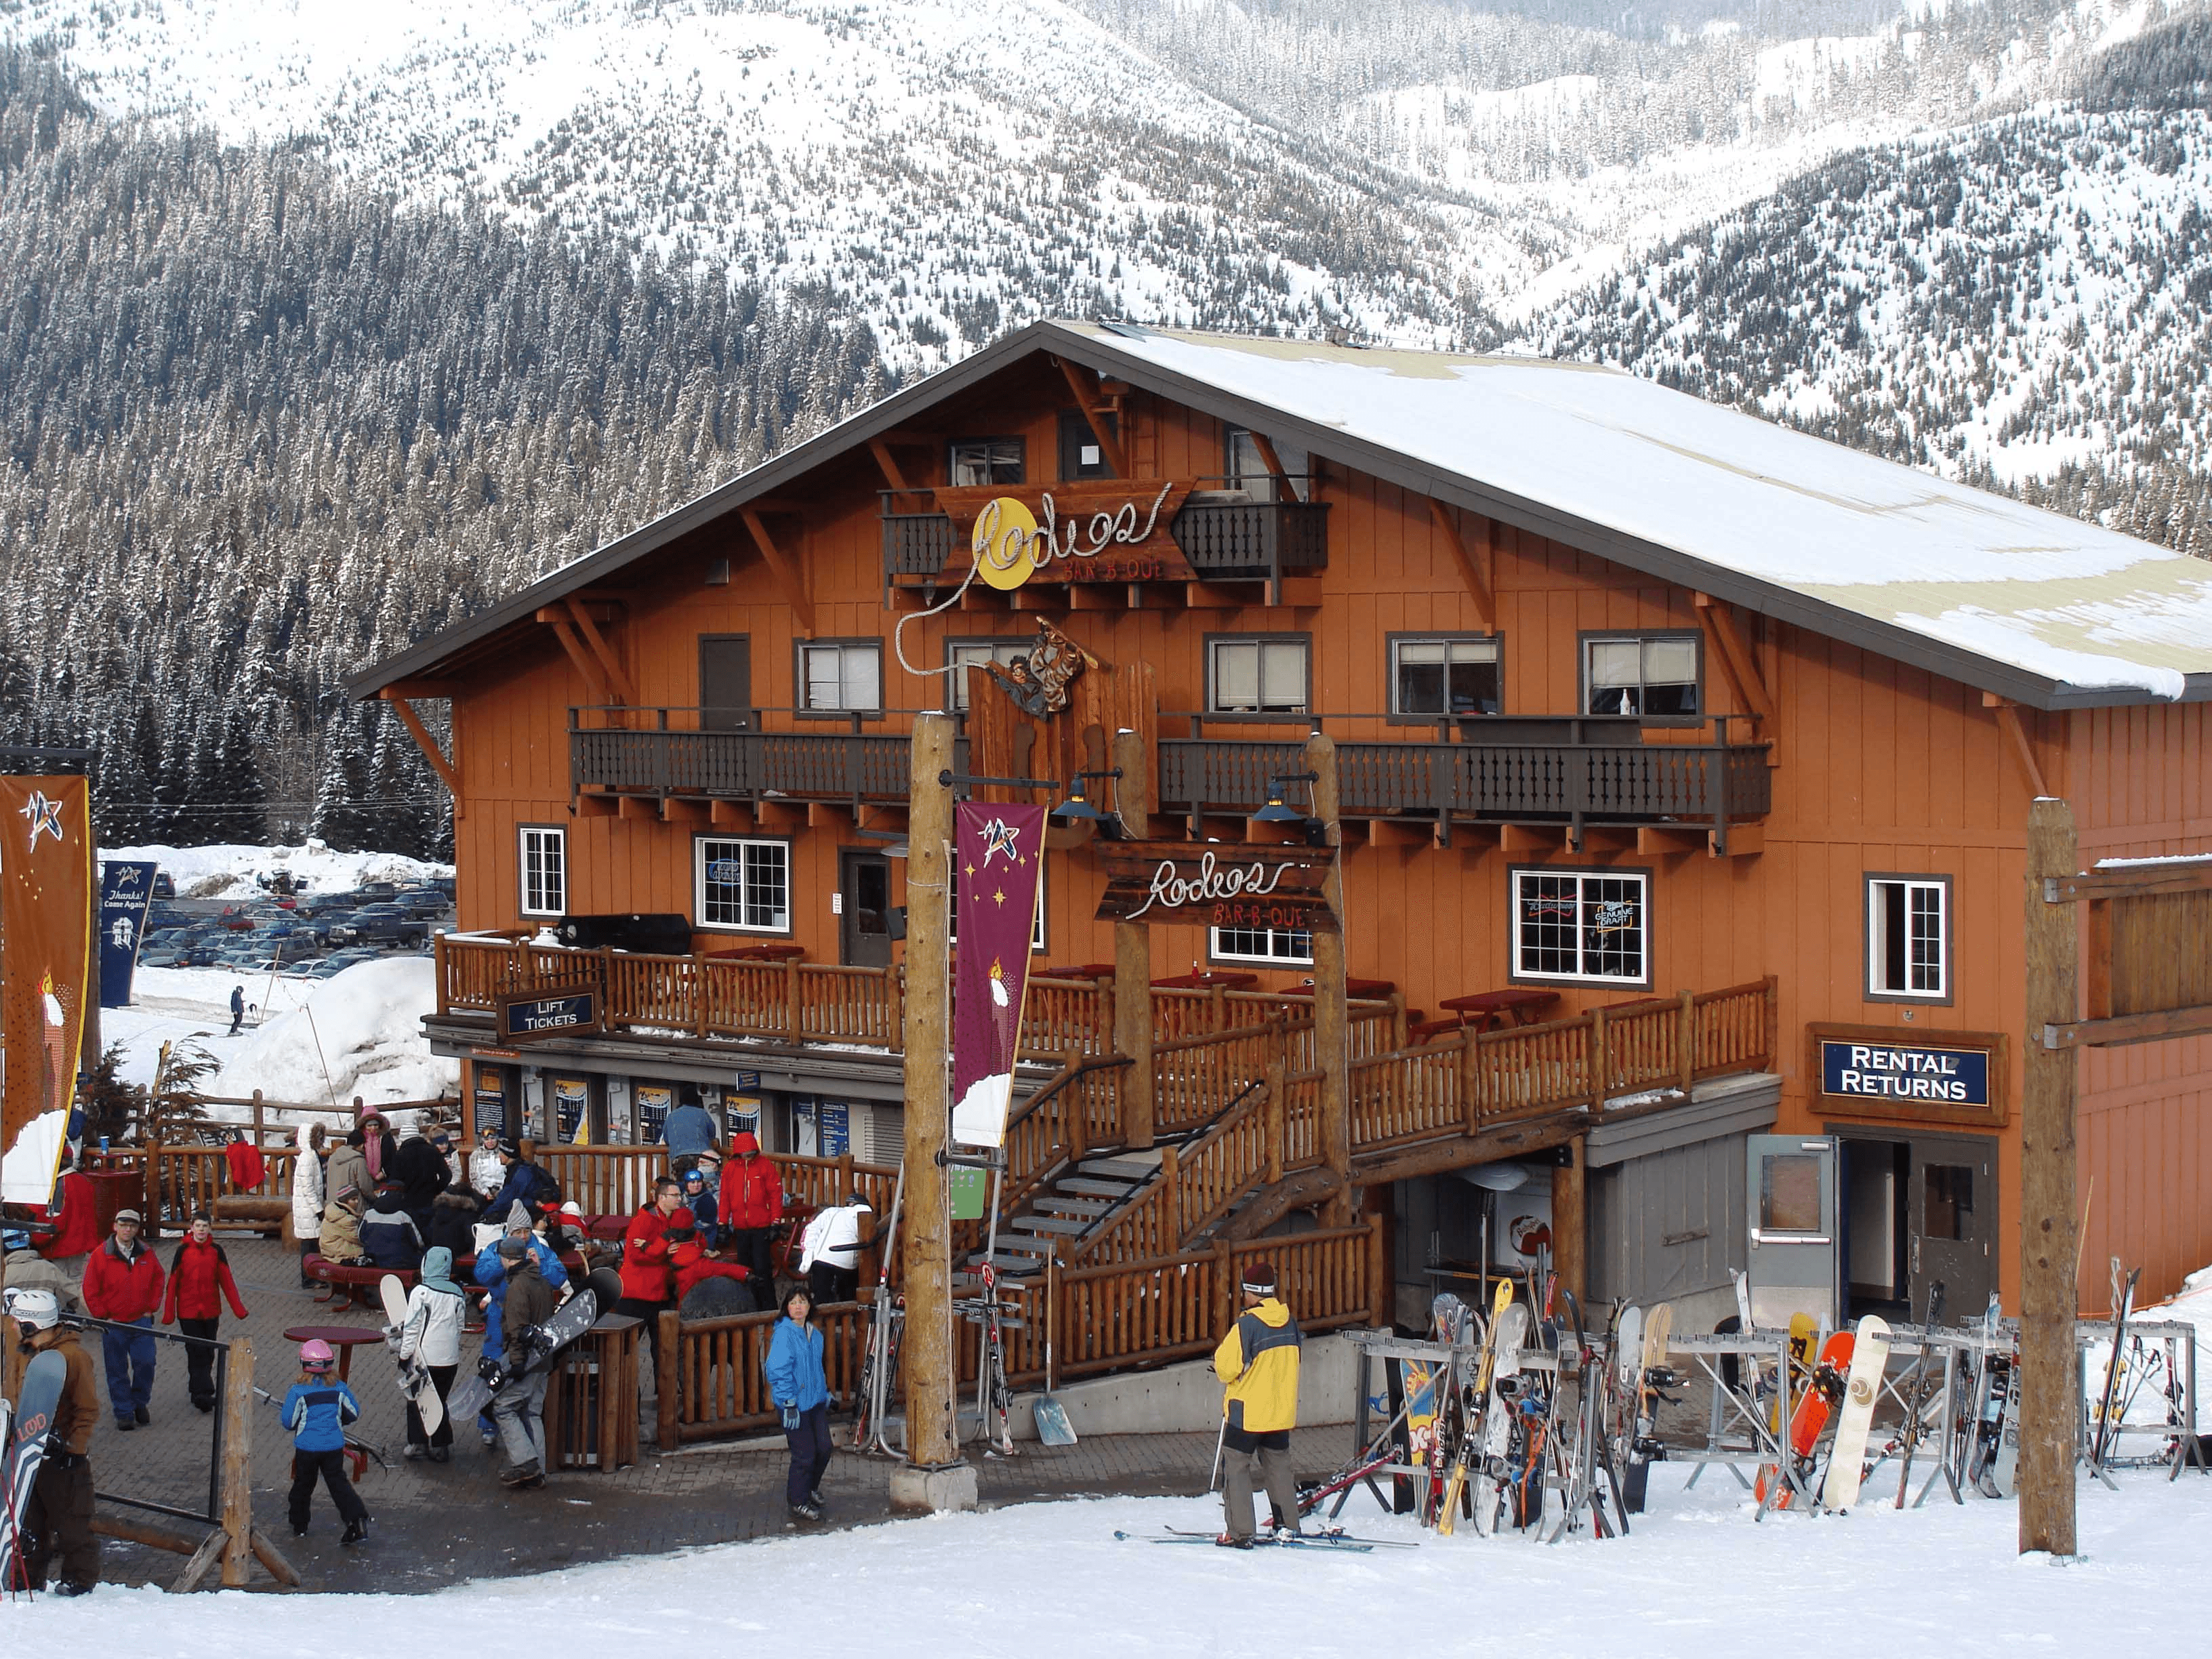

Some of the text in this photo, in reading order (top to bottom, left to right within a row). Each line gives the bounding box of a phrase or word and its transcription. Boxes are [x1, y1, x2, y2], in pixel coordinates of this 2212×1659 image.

[972, 481, 1172, 569] Rodeos
[1126, 851, 1295, 920] Rodeos
[108, 890, 144, 900] Thanks!
[104, 900, 146, 910] Come Again
[1595, 907, 1634, 921] GENUINE
[1600, 915, 1629, 926] DRAFT
[537, 1000, 565, 1015] LIFT
[525, 1014, 577, 1029] TICKETS
[1851, 1046, 1957, 1076] RENTAL
[1841, 1069, 1967, 1101] RETURNS
